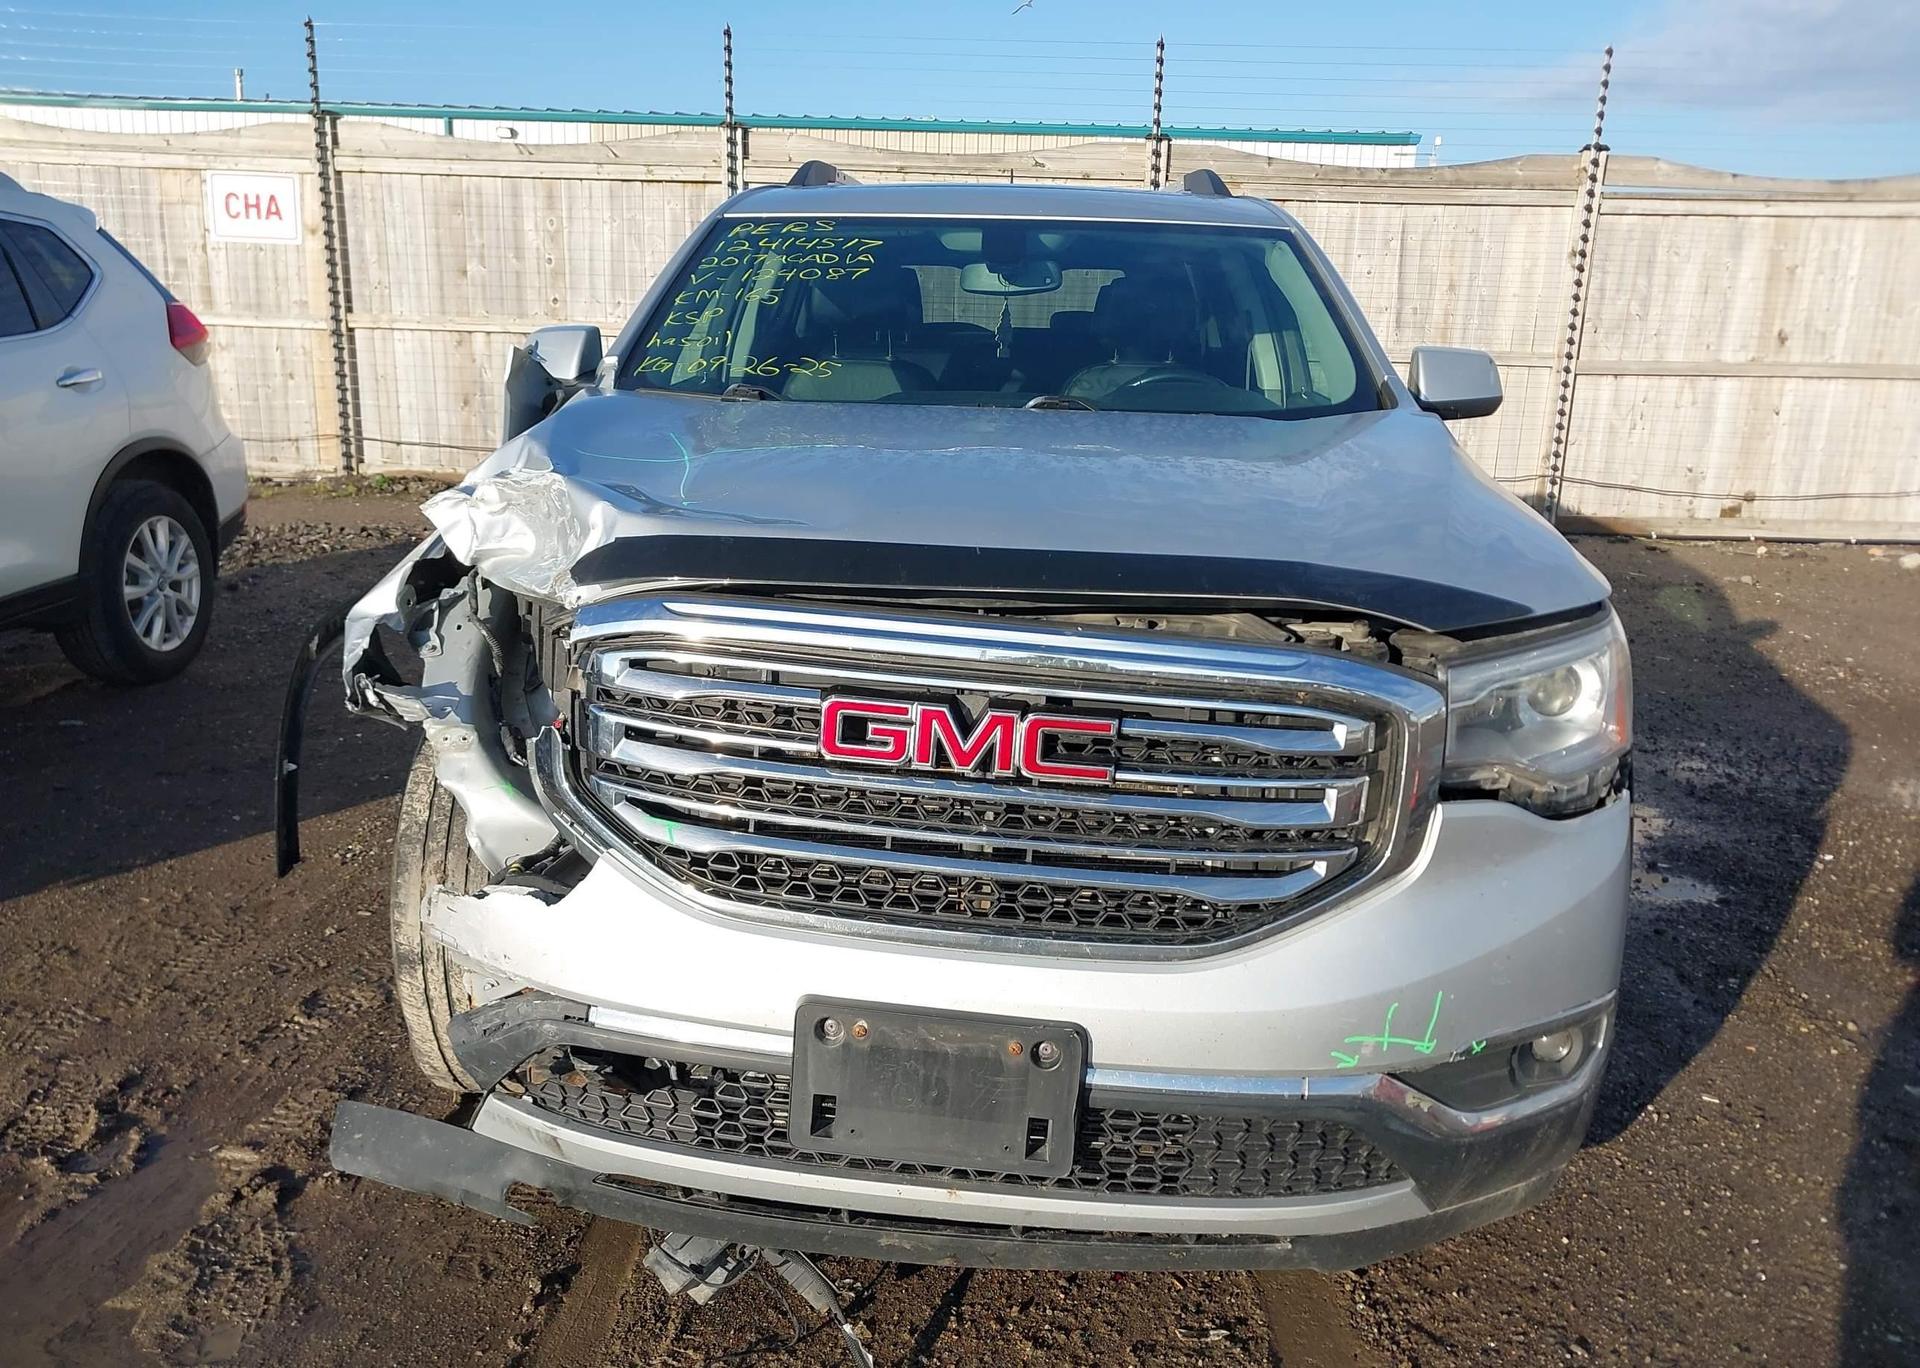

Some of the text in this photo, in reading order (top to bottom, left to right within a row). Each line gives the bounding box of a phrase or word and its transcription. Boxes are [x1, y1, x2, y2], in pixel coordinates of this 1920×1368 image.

[225, 192, 283, 220] CHA
[728, 220, 836, 238] PERS
[820, 695, 1118, 783] GMC
